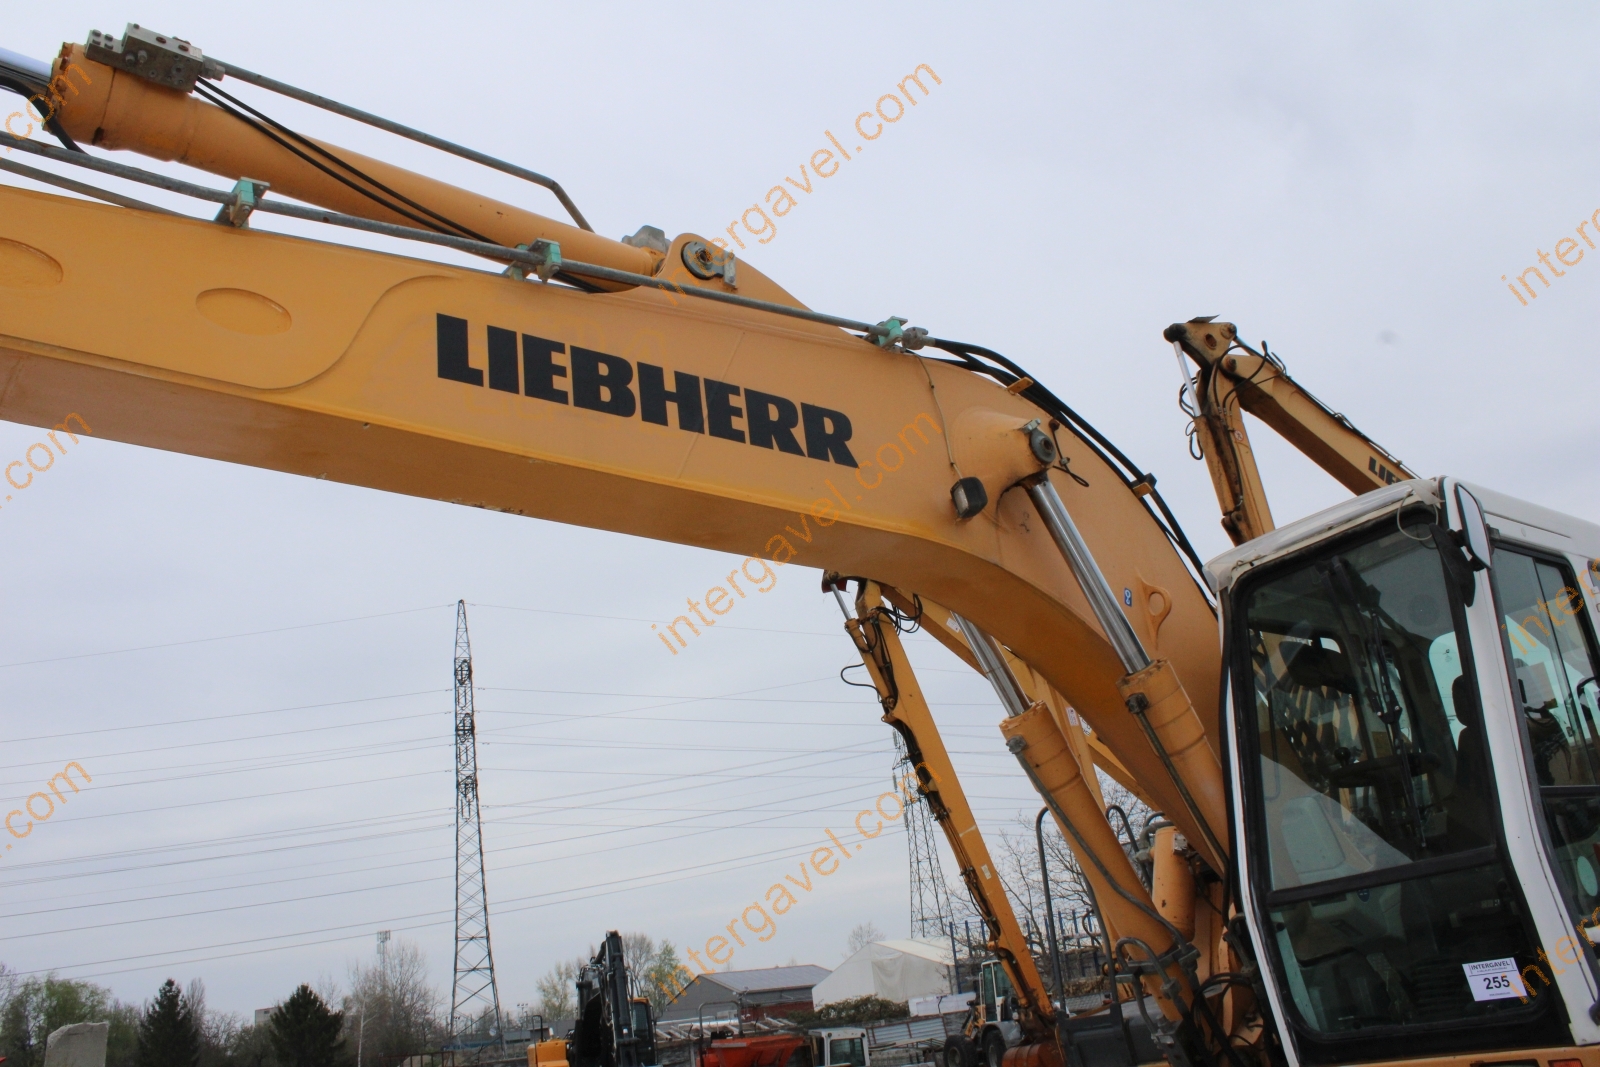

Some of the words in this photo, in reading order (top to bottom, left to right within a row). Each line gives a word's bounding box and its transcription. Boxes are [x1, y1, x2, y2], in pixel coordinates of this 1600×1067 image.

[436, 312, 859, 469] LIEBHERR
[1368, 455, 1402, 486] LIE
[1471, 960, 1510, 971] INTERGAVEL
[1483, 975, 1510, 990] 255
